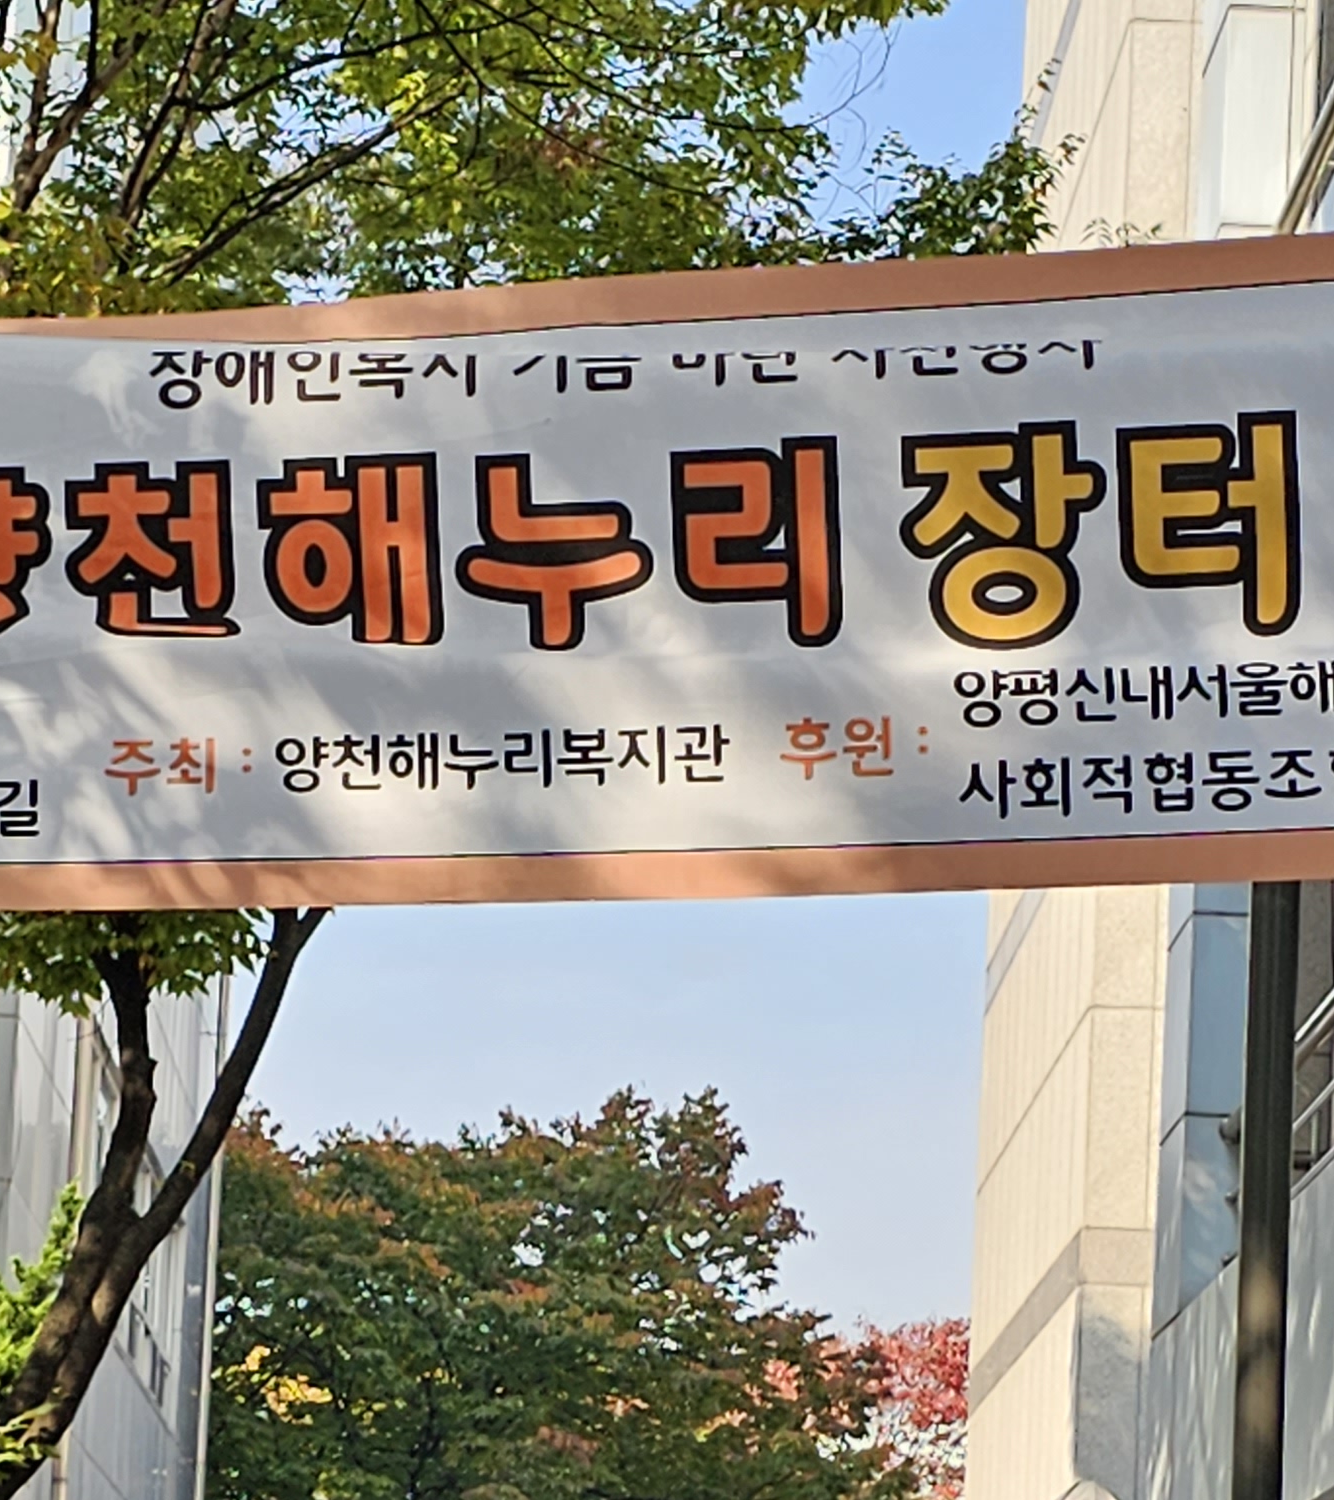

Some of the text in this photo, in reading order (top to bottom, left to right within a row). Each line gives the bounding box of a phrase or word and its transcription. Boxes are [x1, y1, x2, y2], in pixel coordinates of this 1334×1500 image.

[899, 409, 1301, 650] 장터
[104, 738, 217, 795] 주최
[275, 724, 730, 793] 양천해누리복지관
[778, 716, 893, 781] 후원
